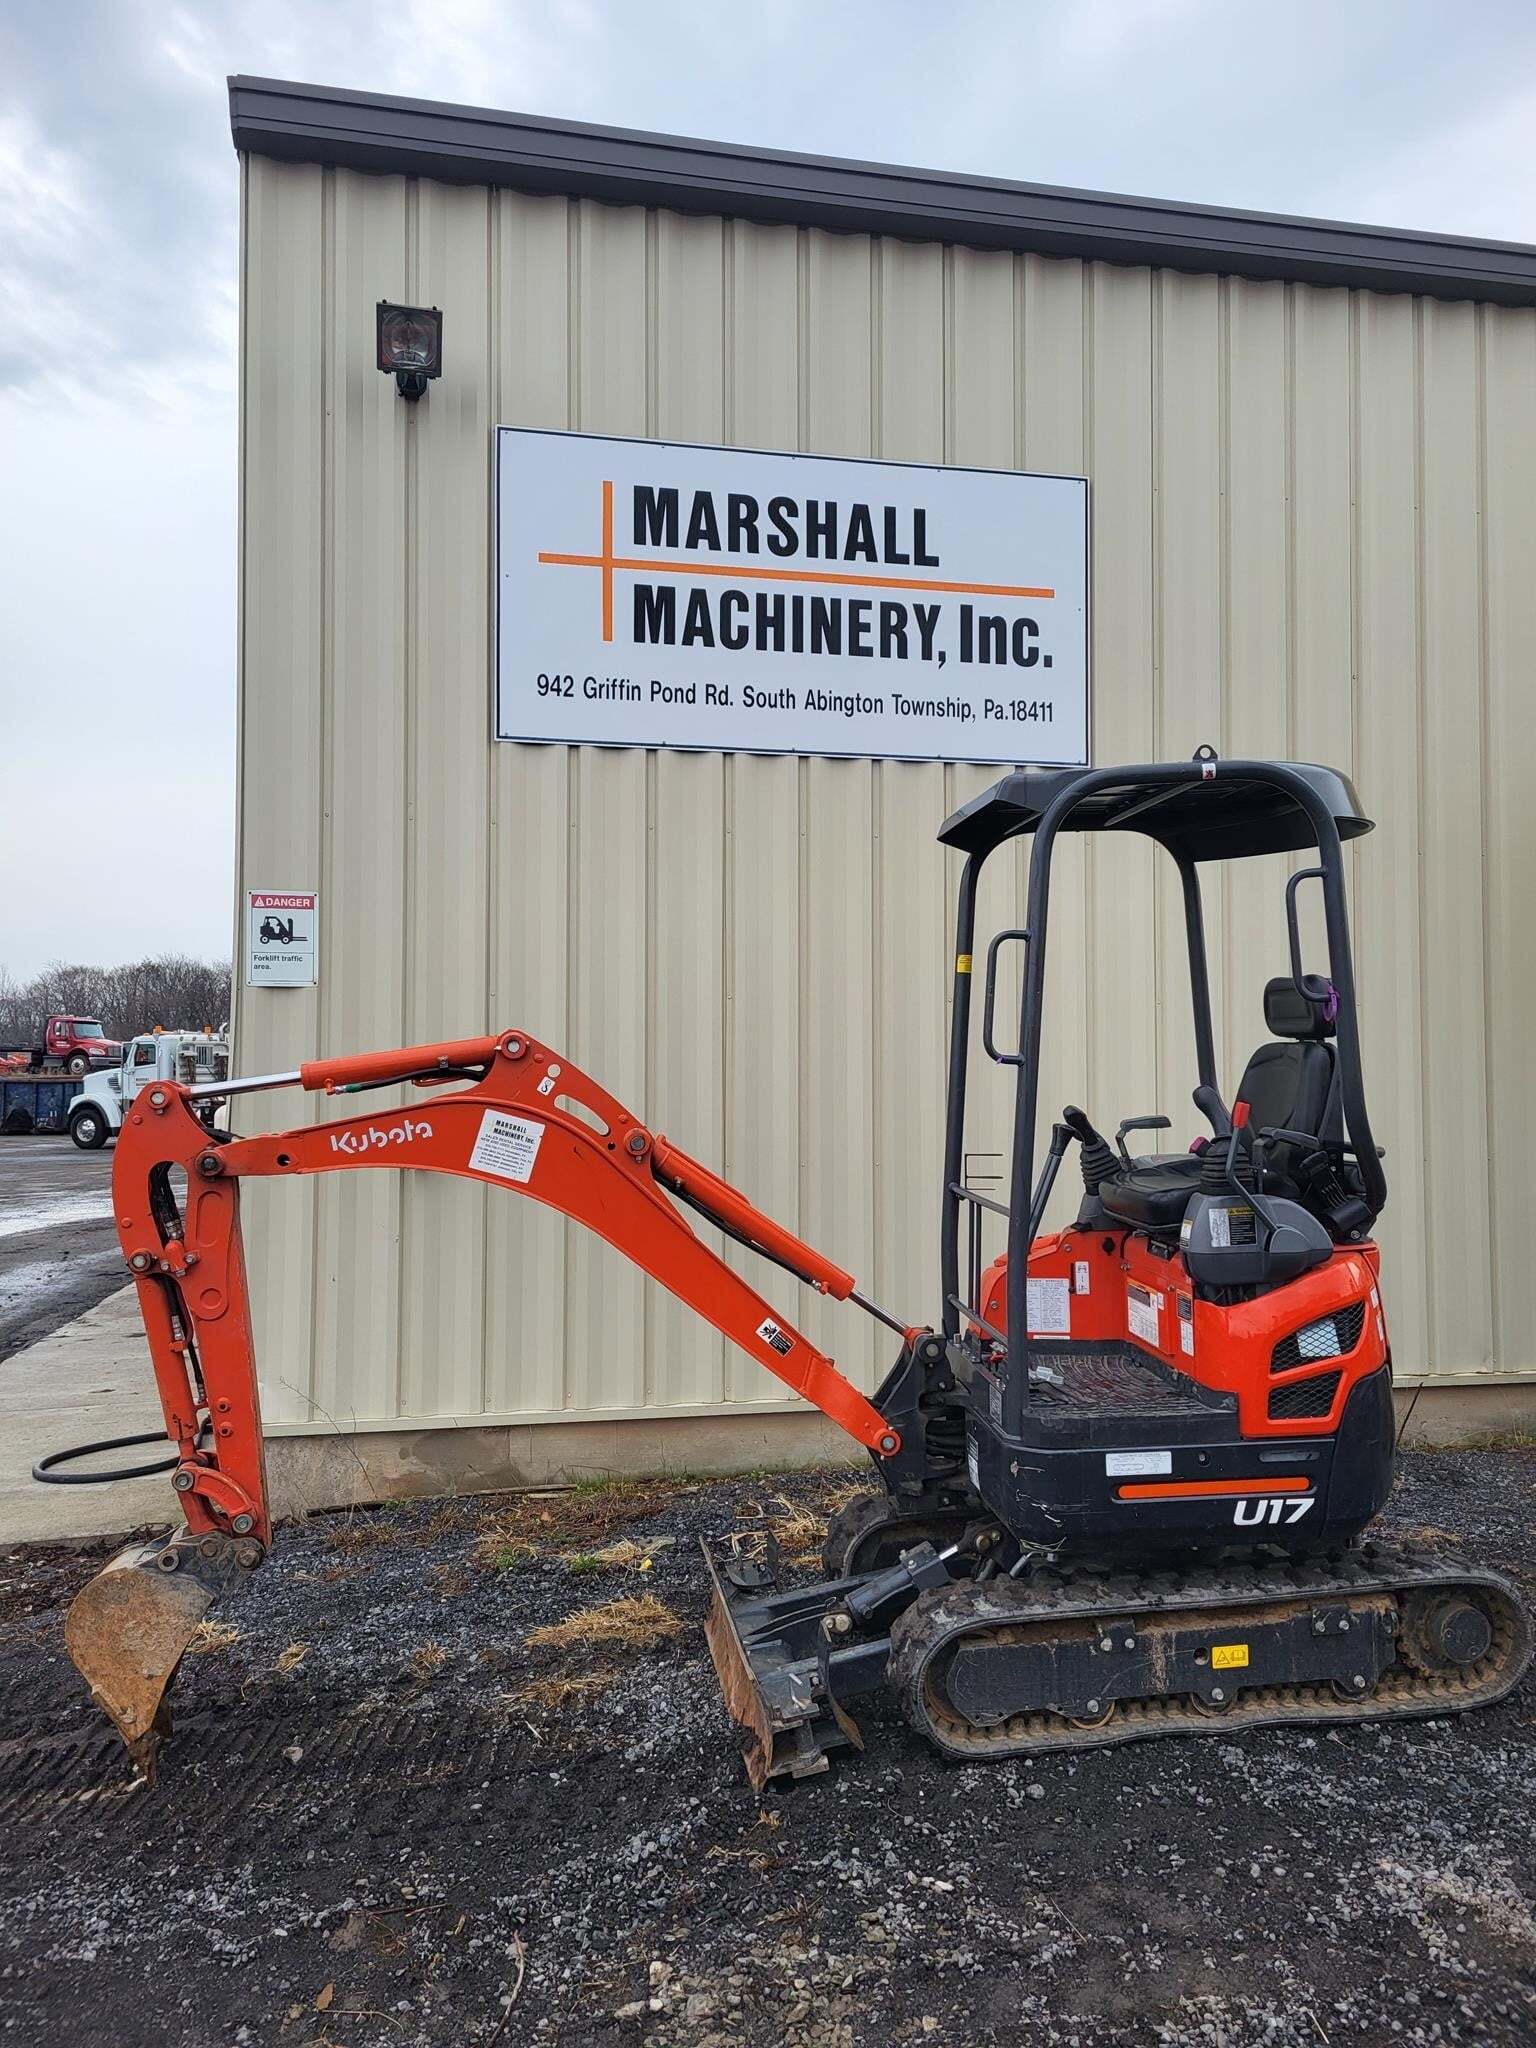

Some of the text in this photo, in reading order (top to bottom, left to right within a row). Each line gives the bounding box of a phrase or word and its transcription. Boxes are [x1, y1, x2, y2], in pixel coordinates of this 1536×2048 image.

[633, 485, 940, 568] MARSHALL
[633, 583, 1053, 670] MACHINERY, Inc.
[536, 673, 575, 698] 942
[582, 676, 642, 702] Griffin
[650, 679, 697, 705] Pond
[705, 683, 734, 707] Rd.
[742, 684, 796, 710] South
[804, 688, 884, 718] Abington
[891, 693, 976, 723] Township,
[265, 897, 310, 907] DANGER
[253, 954, 280, 962] Forklift
[330, 1119, 433, 1154] Kubota
[495, 1119, 527, 1134] MARSHALL
[1233, 1497, 1315, 1526] U17
